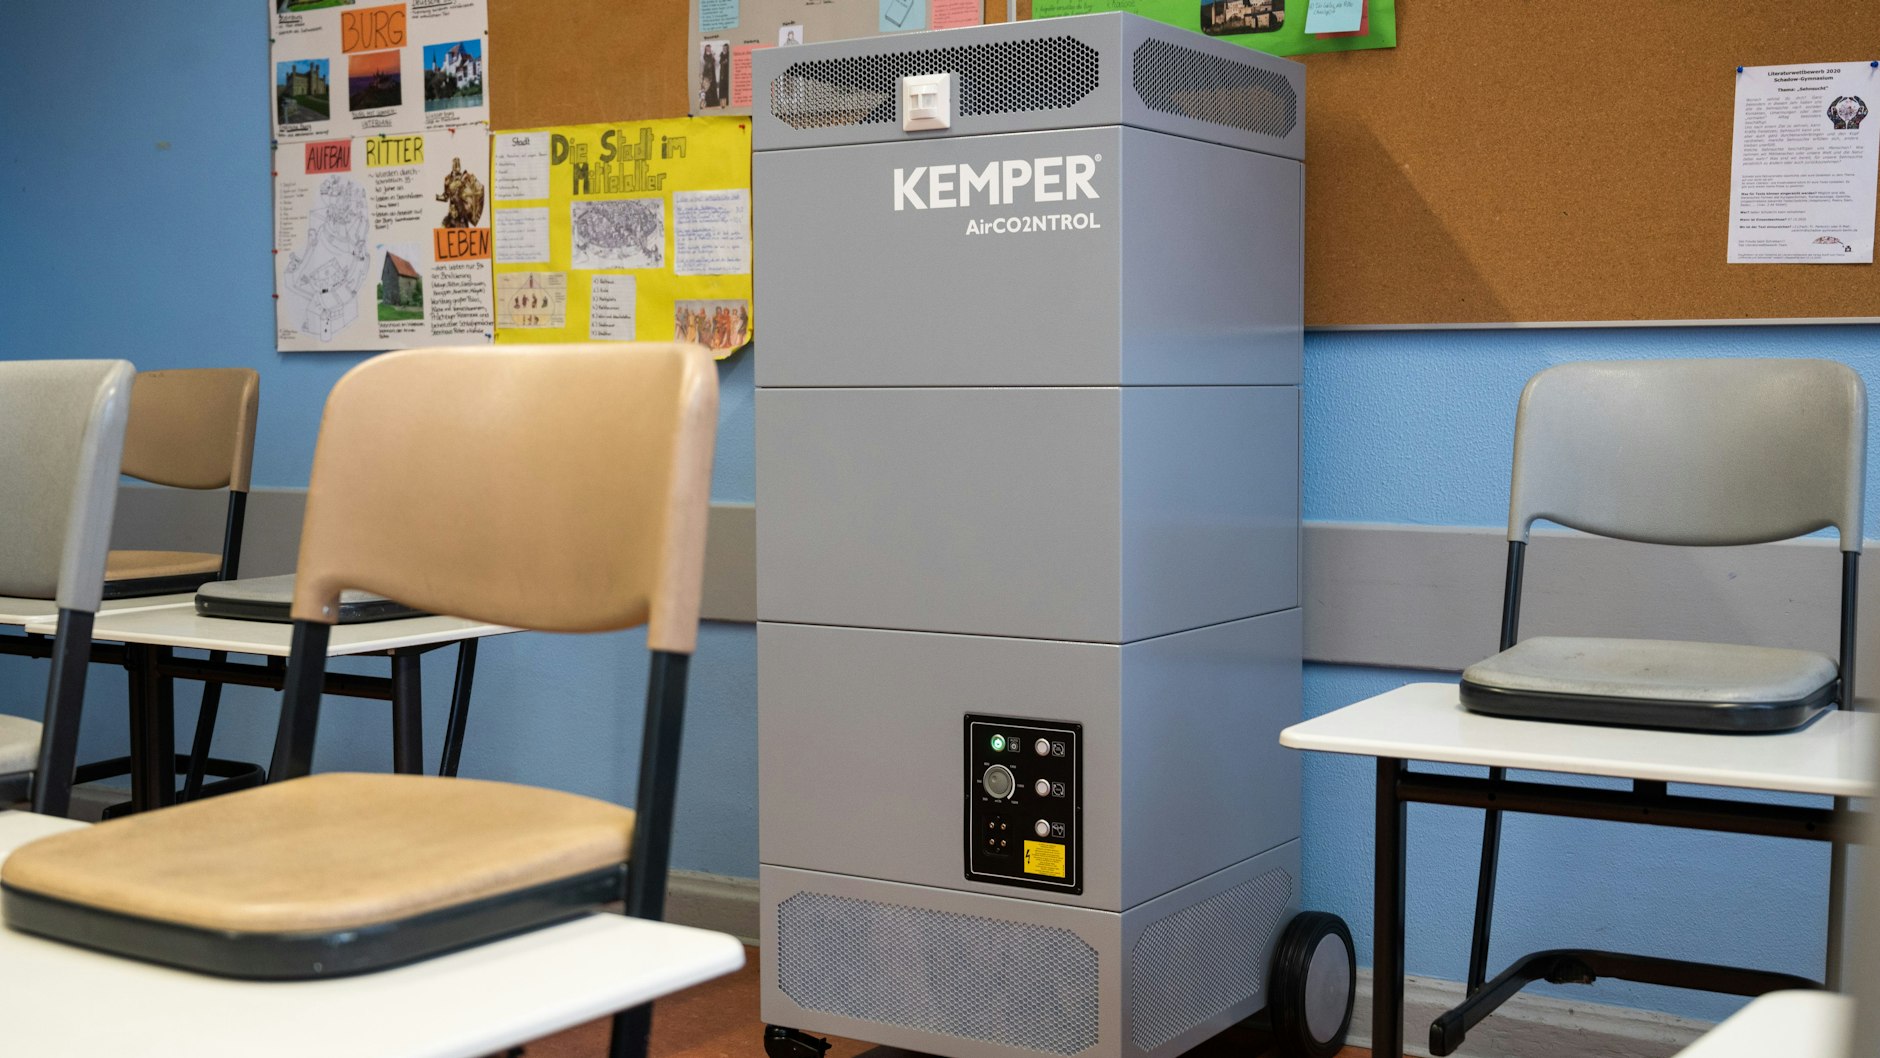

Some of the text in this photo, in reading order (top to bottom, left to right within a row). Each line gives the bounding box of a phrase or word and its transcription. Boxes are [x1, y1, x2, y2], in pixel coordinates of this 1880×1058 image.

[342, 12, 405, 51] BURG
[306, 146, 350, 171] AUFBAU
[366, 137, 424, 166] RITTER
[551, 127, 687, 166] Die Stadt im
[573, 161, 667, 195] Mittelalter
[894, 154, 1100, 210] KEMPER
[965, 212, 1101, 236] AirCO2NTROL
[436, 230, 490, 259] LEBEN
